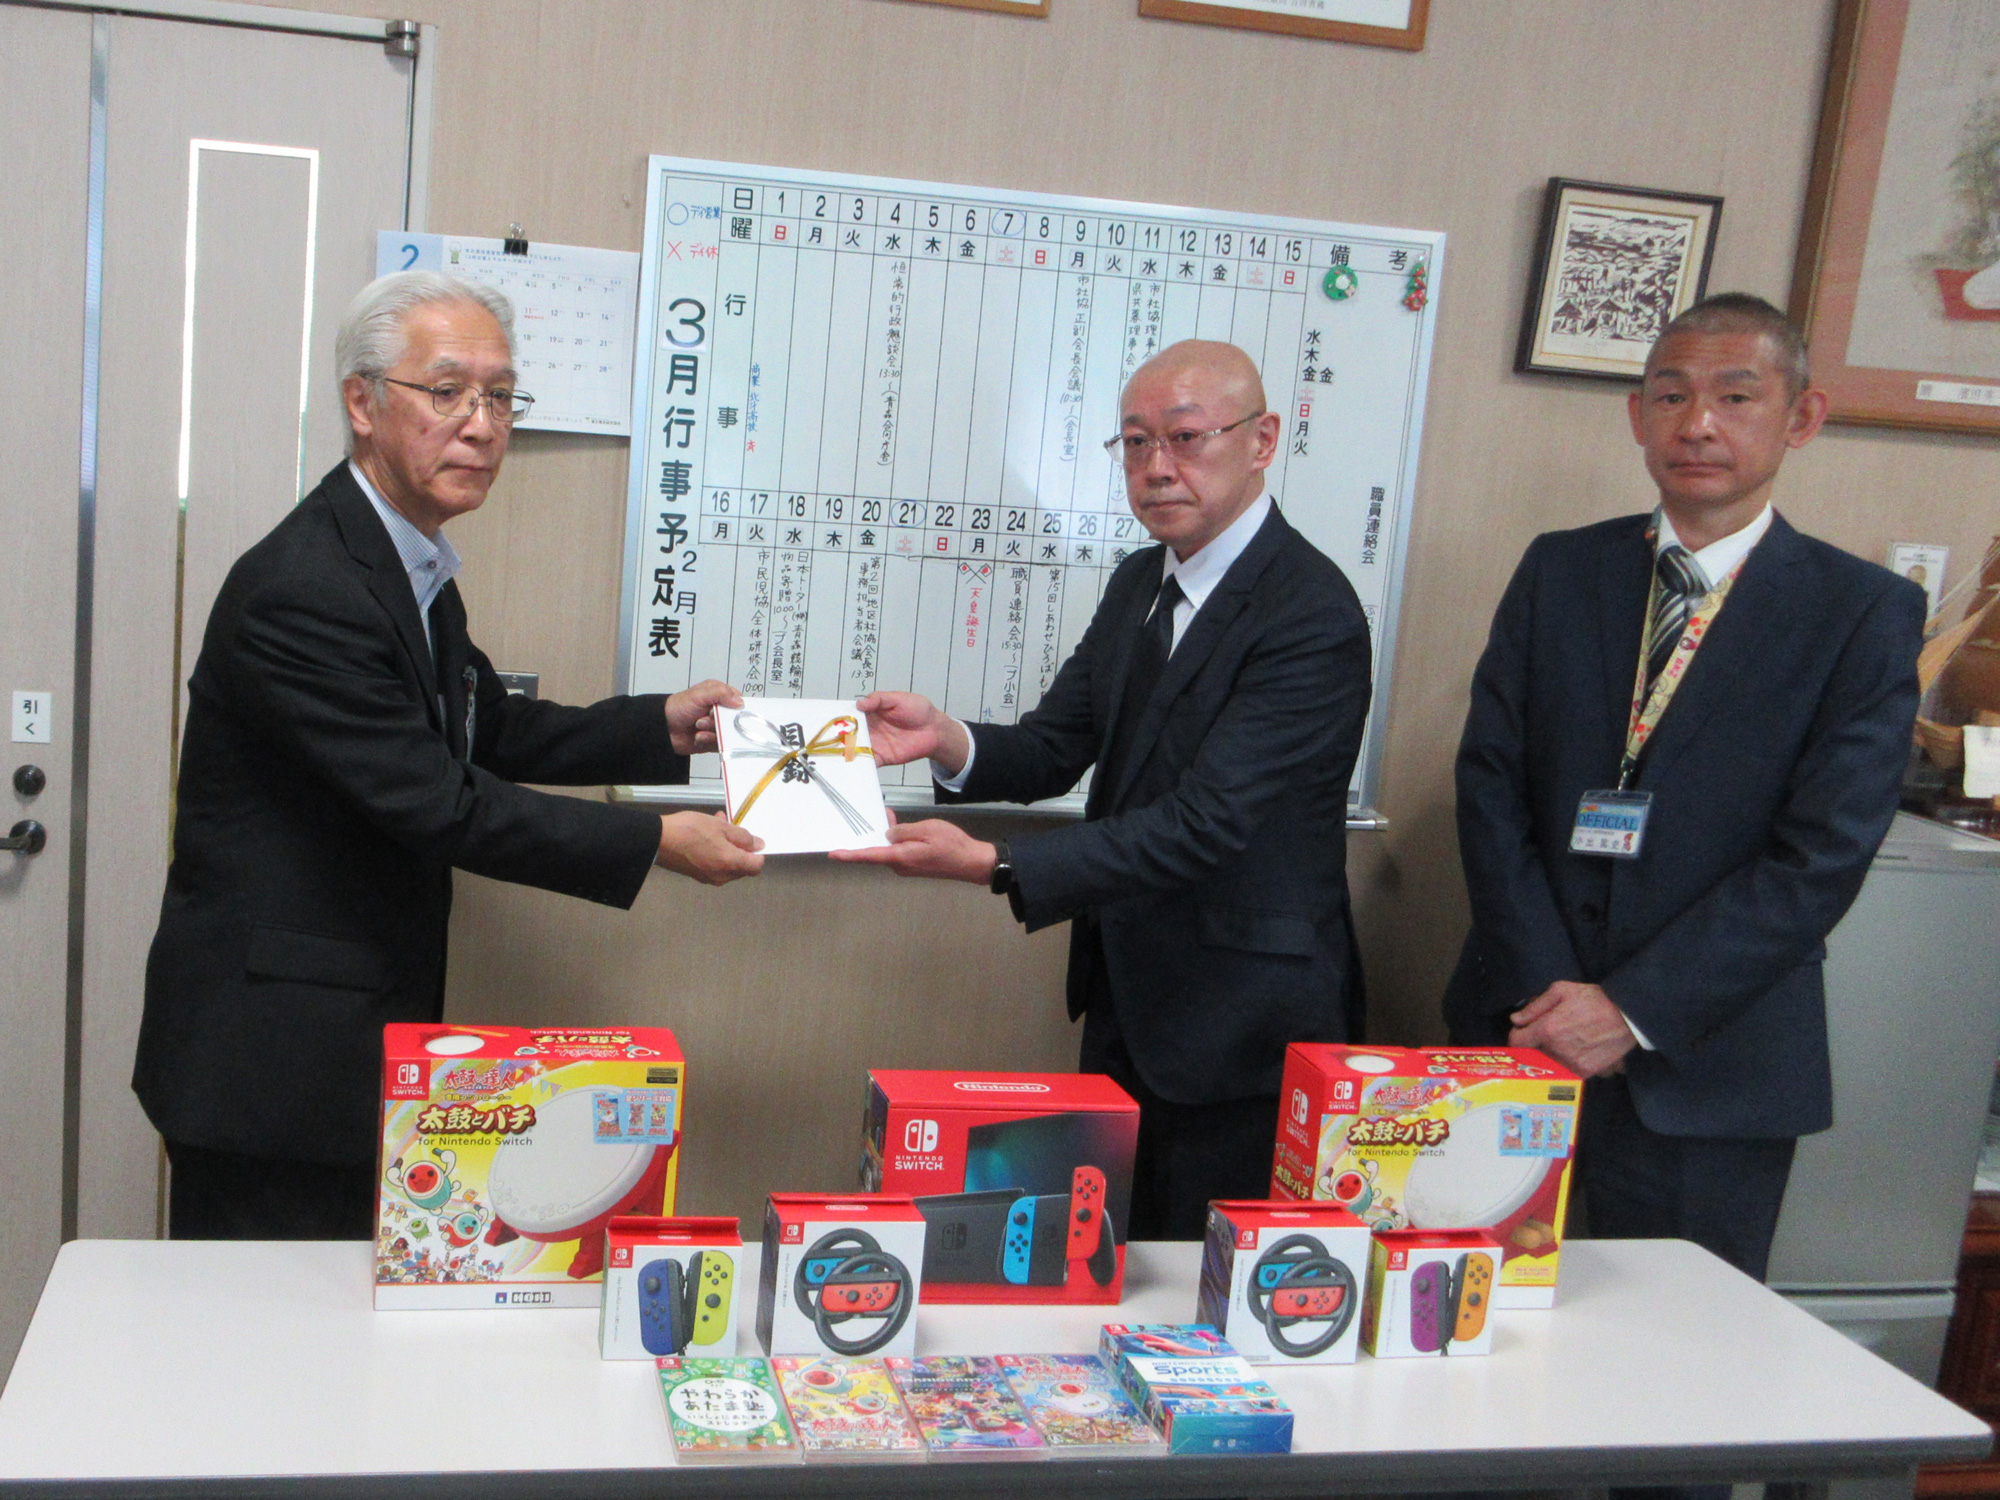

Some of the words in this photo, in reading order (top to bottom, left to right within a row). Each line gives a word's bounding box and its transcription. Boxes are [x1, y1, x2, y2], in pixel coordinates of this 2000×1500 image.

[733, 187, 753, 210] 日
[778, 191, 785, 213] 1
[815, 195, 826, 217] 2
[853, 198, 864, 220] 3
[890, 203, 900, 224] 4
[929, 206, 939, 227] 5
[966, 209, 976, 231] 6
[1003, 213, 1014, 235] 7
[1039, 216, 1050, 238] 8
[1075, 220, 1086, 242] 9
[1108, 223, 1125, 246] 10
[1145, 227, 1160, 249] 11
[1179, 230, 1196, 252] 12
[1214, 233, 1232, 255] 13
[1250, 236, 1266, 259] 14
[1285, 240, 1302, 262] 15
[731, 217, 752, 239] 曜
[774, 225, 787, 240] 日
[808, 227, 822, 243] 月
[845, 230, 861, 247] 火
[885, 234, 901, 250] 水
[925, 237, 941, 254] 木
[960, 240, 976, 257] 金
[997, 246, 1014, 262] 土
[1034, 249, 1046, 264] 日
[1071, 252, 1084, 268] 月
[1107, 255, 1121, 271] 火
[1142, 259, 1157, 275] 水
[1179, 261, 1194, 277] 木
[1213, 264, 1227, 281] 金
[1250, 267, 1263, 284] 土
[1284, 271, 1295, 285] 日
[551, 309, 559, 317] 12
[576, 311, 584, 319] 13
[601, 313, 609, 321] 14
[1319, 367, 1334, 384] 金
[712, 491, 730, 513] 16
[750, 493, 768, 515] 17
[788, 495, 805, 517] 18
[825, 498, 843, 520] 19
[862, 500, 881, 522] 20
[899, 502, 917, 524] 21
[935, 505, 954, 527] 22
[971, 508, 991, 530] 23
[1007, 510, 1025, 532] 24
[1043, 513, 1062, 534] 25
[1078, 515, 1097, 536] 26
[1115, 517, 1134, 538] 27
[715, 523, 728, 539] 月
[750, 524, 764, 540] 火
[786, 527, 802, 543] 水
[826, 531, 842, 547] 木
[860, 529, 875, 545] 金
[897, 535, 912, 551] 土
[936, 537, 948, 551] 日
[972, 538, 985, 553] 月
[1006, 540, 1020, 556] 火
[1042, 543, 1057, 559] 水
[1077, 546, 1092, 561] 木
[674, 550, 697, 615] 2月
[966, 587, 983, 648] 天皇誕生日
[23, 699, 38, 735] 引く
[1577, 813, 1637, 831] OFFICIAL
[961, 1083, 1043, 1091] Nintendo
[418, 1104, 532, 1132] 太鼓とバチ
[418, 1136, 435, 1146] for
[438, 1136, 491, 1146] Nintendo
[494, 1136, 533, 1146] Switch
[1350, 1119, 1446, 1143] 太鼓とバチ
[1365, 1149, 1409, 1157] Nintendo
[1412, 1149, 1445, 1157] Switch
[895, 1161, 944, 1170] SWITCH
[1154, 1365, 1239, 1377] Sports
[680, 1388, 760, 1399] やわらか
